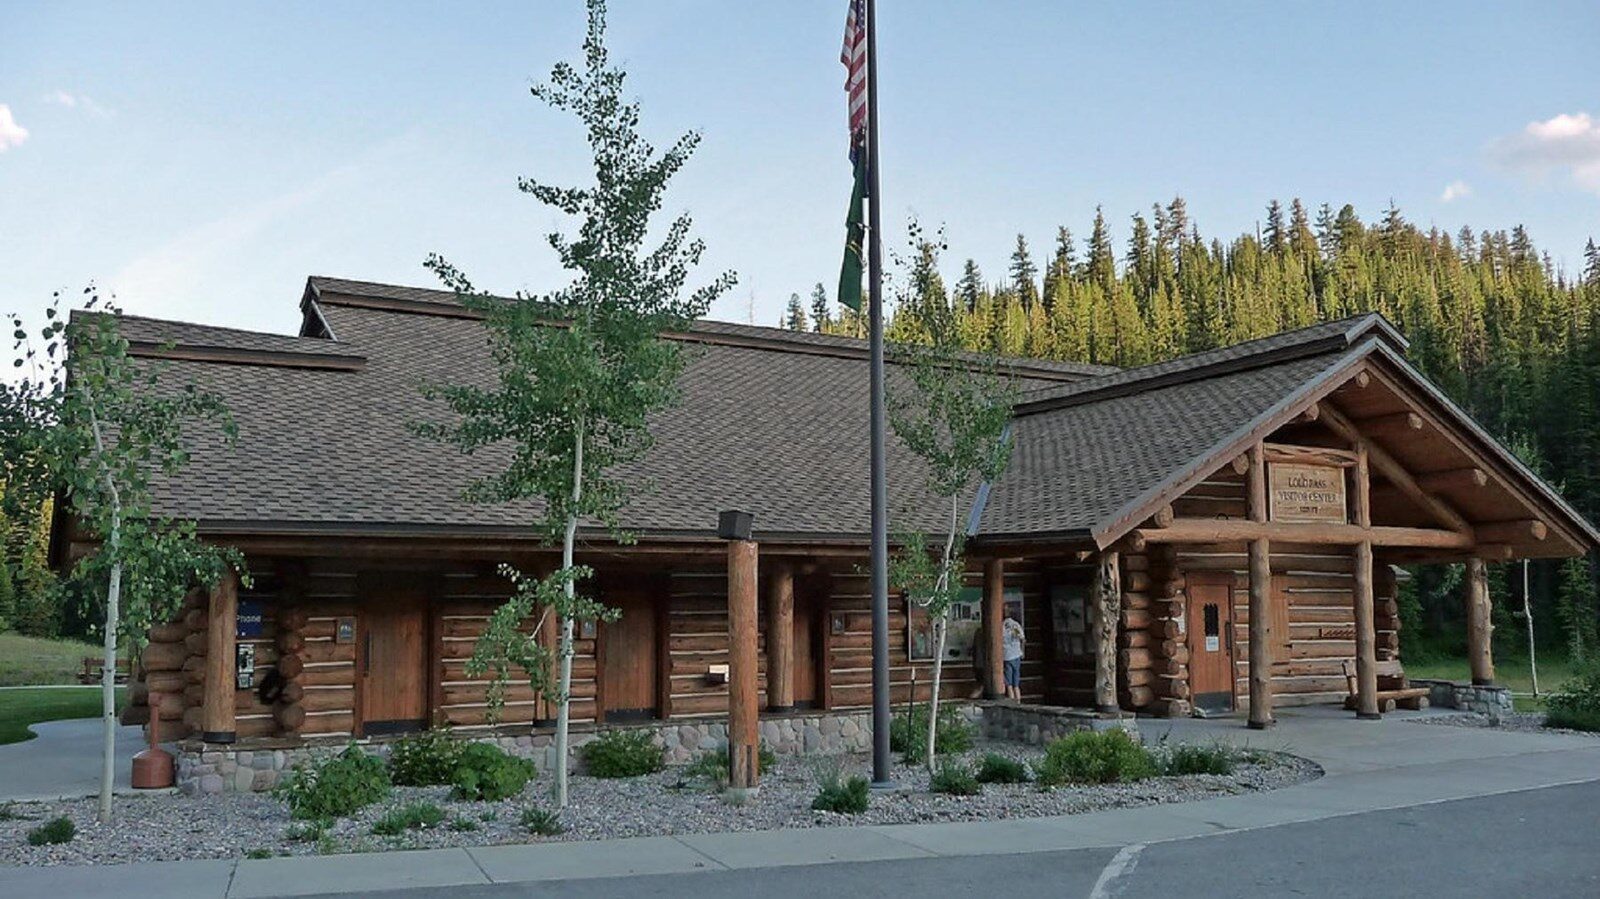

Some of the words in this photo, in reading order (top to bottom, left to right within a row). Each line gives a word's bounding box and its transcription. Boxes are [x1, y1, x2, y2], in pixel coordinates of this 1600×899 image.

[1288, 477, 1308, 488] LOLO
[1308, 479, 1327, 489] PASS
[1278, 491, 1308, 501] VISITOR
[1308, 491, 1336, 503] CENTER
